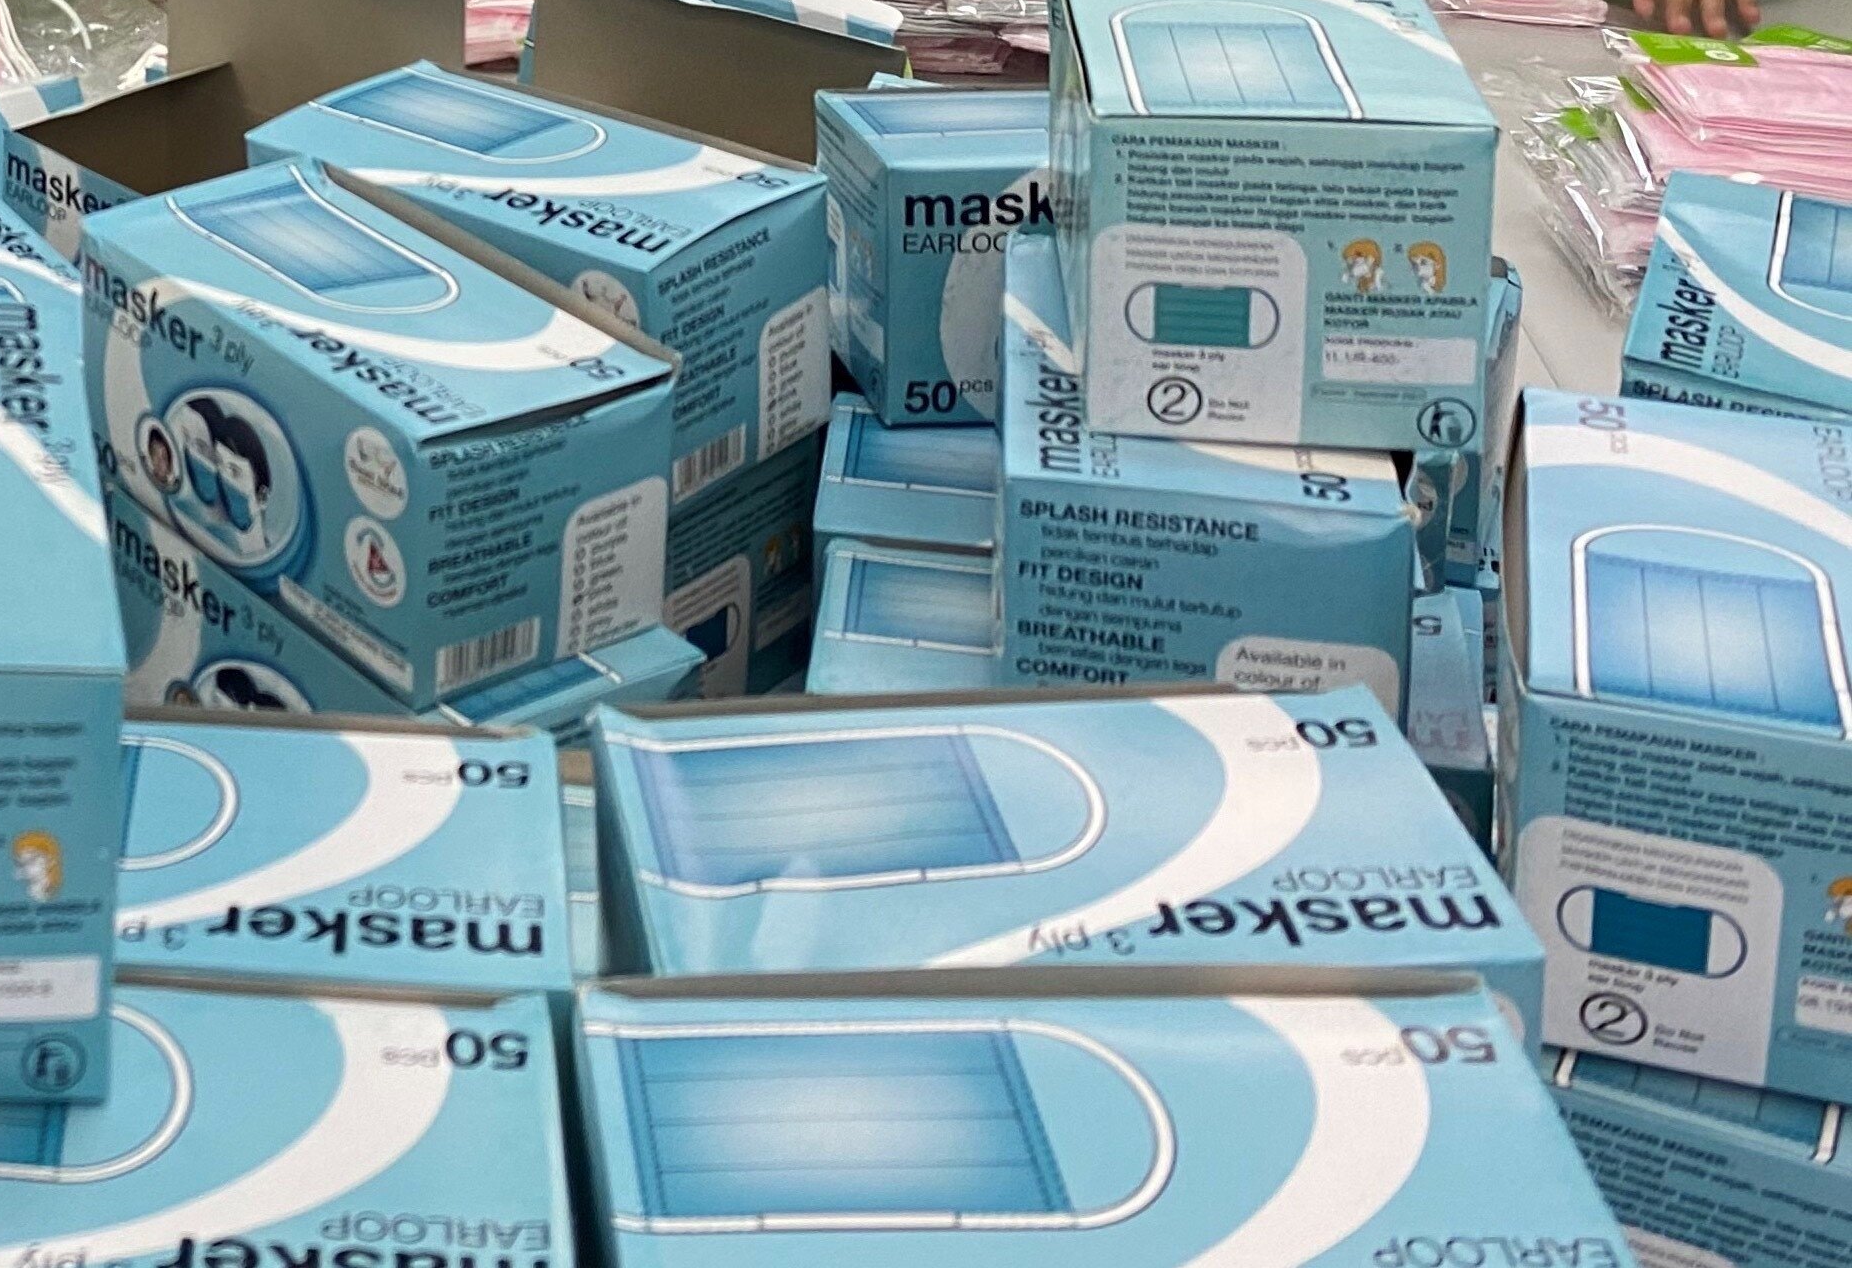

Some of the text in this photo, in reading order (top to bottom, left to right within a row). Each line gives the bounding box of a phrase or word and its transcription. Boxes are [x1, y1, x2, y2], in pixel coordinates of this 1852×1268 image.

[736, 171, 790, 189] 50
[483, 186, 673, 255] masker
[82, 258, 203, 359] masker
[1657, 278, 1717, 369] masker
[289, 329, 459, 425] masker
[569, 355, 625, 380] 50
[904, 378, 993, 415] 50 pcs
[1633, 379, 1722, 410] SPLASH
[1025, 367, 1081, 474] masker
[1578, 400, 1626, 432] 50
[458, 487, 520, 516] DESIGN
[1300, 472, 1350, 501] 50
[1020, 499, 1260, 542] SPLASH RESISTANCE
[115, 513, 236, 634] masker
[427, 571, 509, 608] COMFORT
[1018, 559, 1144, 591] FIT DESIGN
[1097, 591, 1127, 605] dan
[1017, 619, 1166, 654] BREATHABLE
[1016, 656, 1130, 686] COMFORT
[1235, 645, 1346, 671] Available in
[1296, 718, 1377, 748] 50
[457, 759, 530, 790] 50
[1273, 864, 1480, 893] EARLOOP
[348, 885, 545, 919] EARLOOP
[208, 904, 544, 957] masker
[1027, 893, 1501, 957] masker 3 ply
[444, 1028, 529, 1070] 50
[1400, 1026, 1496, 1064] 50
[321, 1209, 553, 1252] EARLOOP
[1373, 1235, 1619, 1268] EARLOOP
